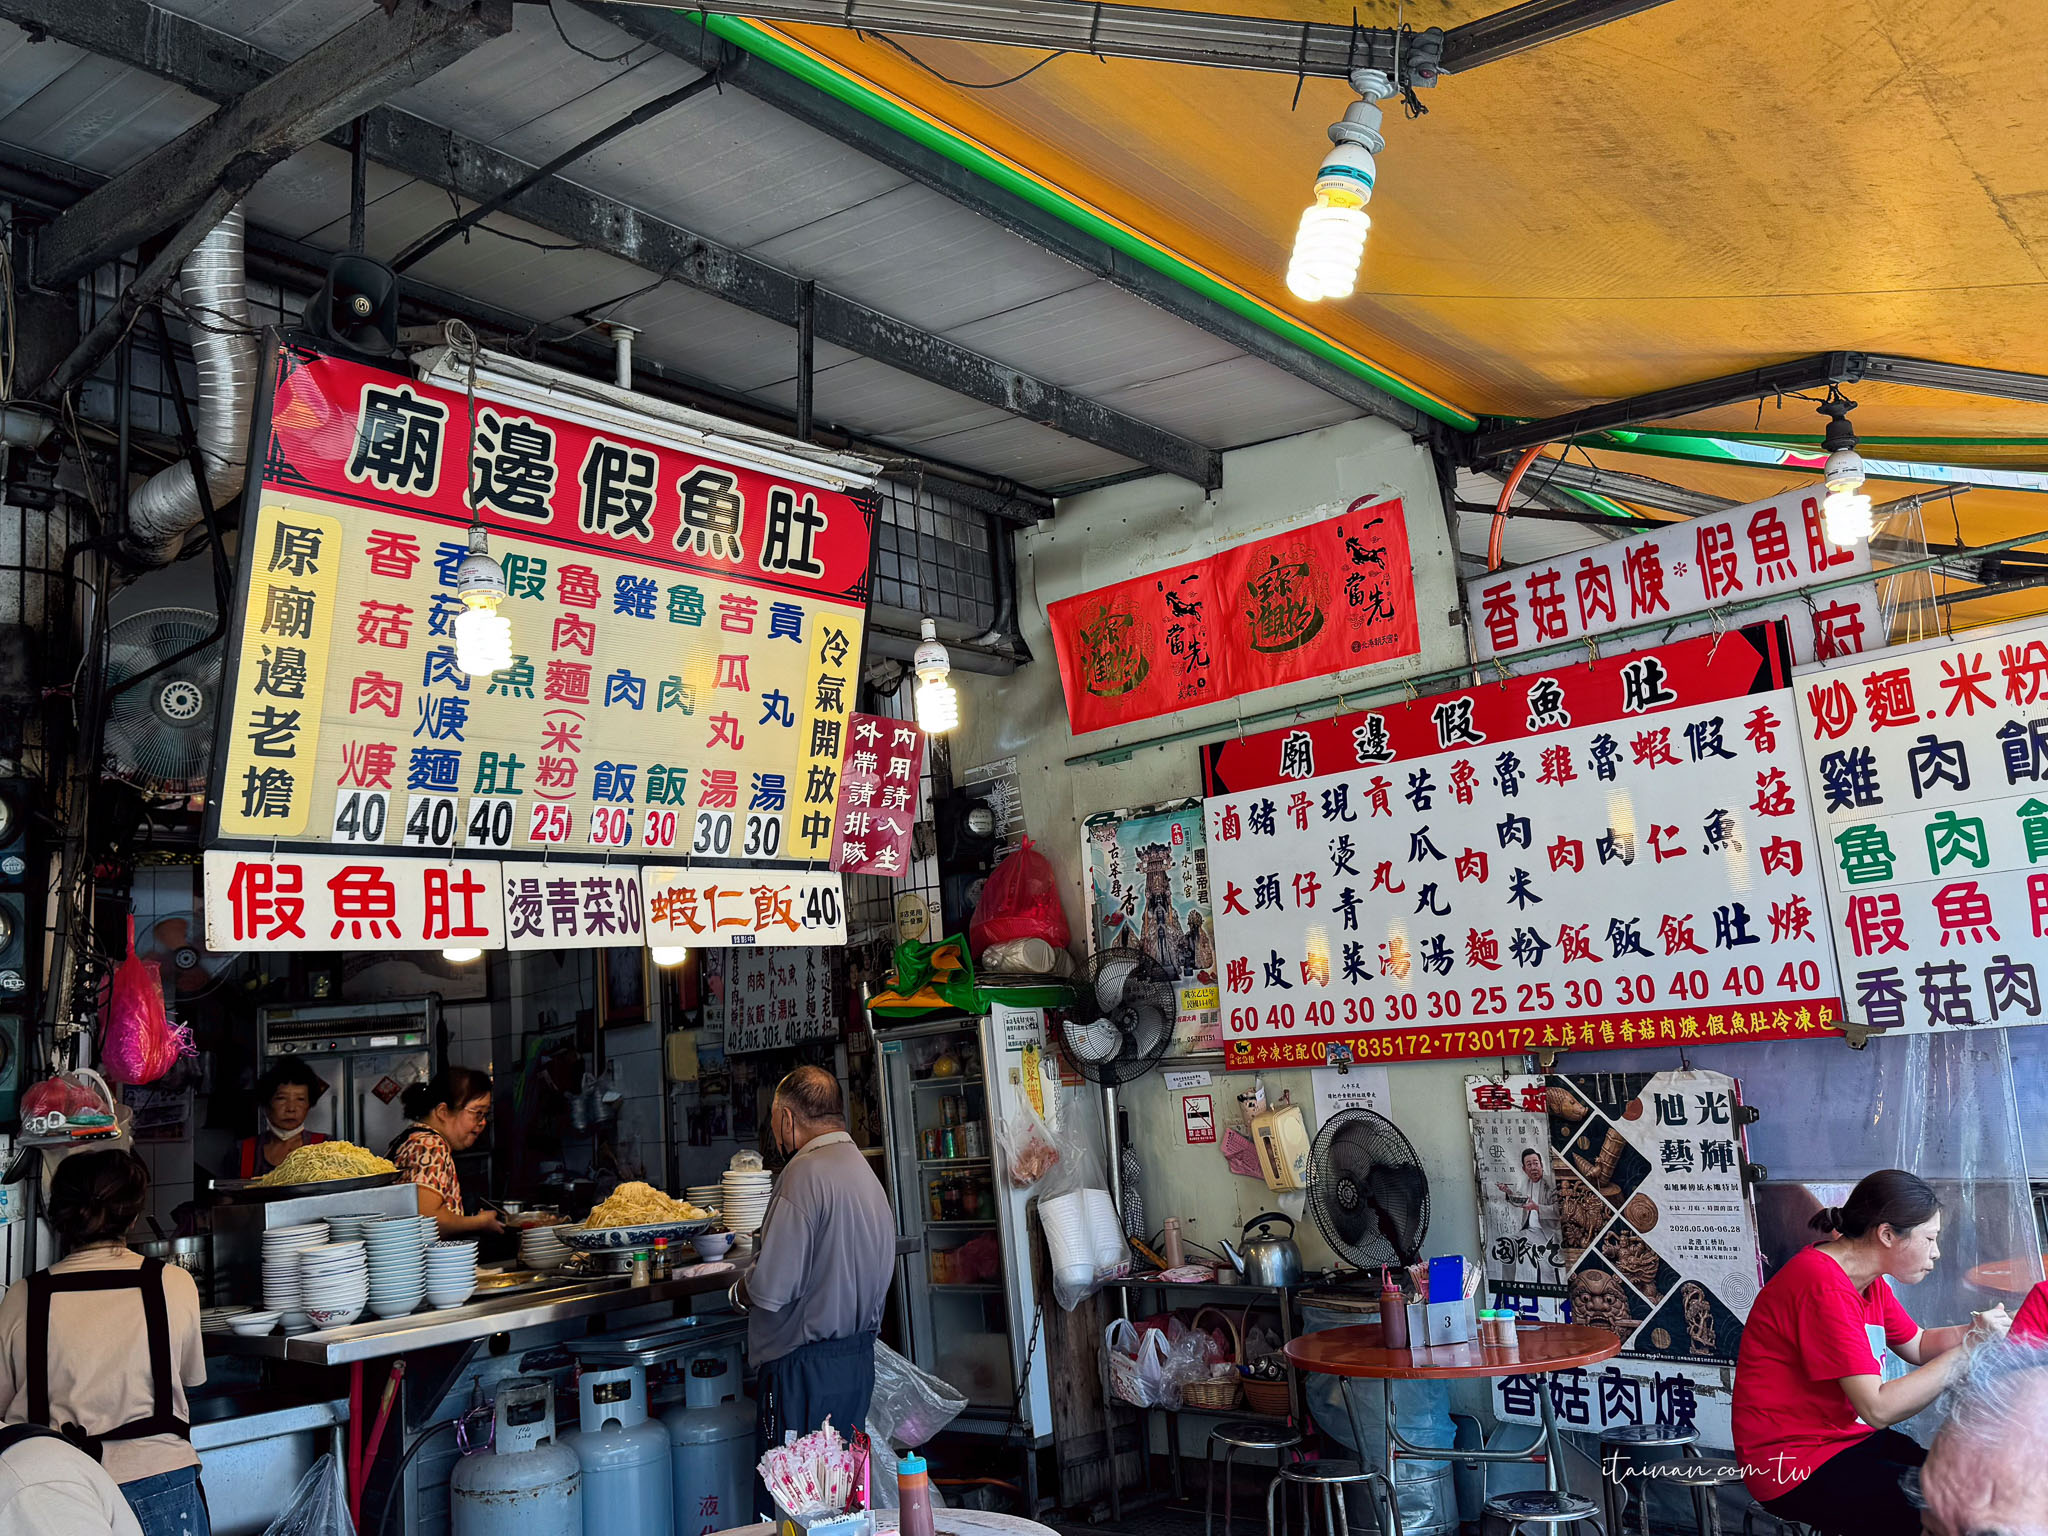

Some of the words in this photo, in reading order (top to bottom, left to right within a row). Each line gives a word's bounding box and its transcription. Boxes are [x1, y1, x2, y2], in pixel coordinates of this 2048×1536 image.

[349, 385, 827, 577] 廟邊假魚肚
[1483, 540, 1671, 652] 香菇肉焿
[240, 519, 325, 819] 原廟邊老擔
[336, 528, 421, 790] 香菇肉焿
[473, 551, 548, 795] 假魚肚
[592, 574, 659, 804] 雞肉飯
[645, 583, 707, 807] 魯肉飯
[698, 592, 758, 809] 苦瓜丸湯
[748, 601, 805, 811] 貢丸湯
[802, 626, 850, 850] 冷氣開放中
[1279, 656, 1678, 780] 廟邊假魚肚
[336, 792, 386, 842] 40
[406, 799, 455, 847] 40
[468, 800, 512, 846] 40
[532, 803, 568, 842] 25
[592, 807, 625, 844] 30
[644, 811, 676, 846] 30
[841, 720, 883, 867] 外帶請排隊
[874, 727, 917, 872] 內用請入坐
[1683, 716, 1760, 950] 假魚肚
[1744, 705, 1816, 945] 香菇肉焿
[693, 813, 732, 855] 30
[744, 815, 781, 857] 30
[1405, 768, 1455, 976] 苦瓜丸湯
[1448, 759, 1503, 971] 魯肉麵
[1493, 750, 1551, 969] 魯肉米粉
[1536, 744, 1604, 965] 雞肉飯
[1587, 733, 1655, 959] 魯肉飯
[1629, 726, 1709, 956] 蝦仁飯
[227, 861, 489, 940] 假魚肚
[651, 884, 801, 933] 蝦仁飯
[808, 887, 836, 926] 40
[1214, 804, 1256, 994] 滷大腸
[1248, 798, 1293, 989] 豬頭皮
[1287, 791, 1331, 988] 骨仔肉
[1321, 783, 1374, 986] 現燙青菜
[1362, 775, 1412, 979] 貢丸湯
[1304, 999, 1335, 1027] 40
[1344, 996, 1375, 1024] 30
[1385, 992, 1418, 1022] 30
[1428, 988, 1461, 1018] 30
[1472, 986, 1507, 1016] 25
[1517, 982, 1555, 1013] 25
[1565, 978, 1603, 1009] 30
[1616, 974, 1655, 1005] 30
[1669, 969, 1709, 1001] 40
[1722, 964, 1764, 997] 40
[1777, 959, 1820, 993] 40
[1856, 954, 2042, 1029] 香菇肉
[1230, 1005, 1259, 1034] 60
[1266, 1003, 1295, 1030] 40
[1655, 1091, 1730, 1127] 旭光
[1659, 1138, 1736, 1174] 藝輝
[1444, 1315, 1451, 1329] 3
